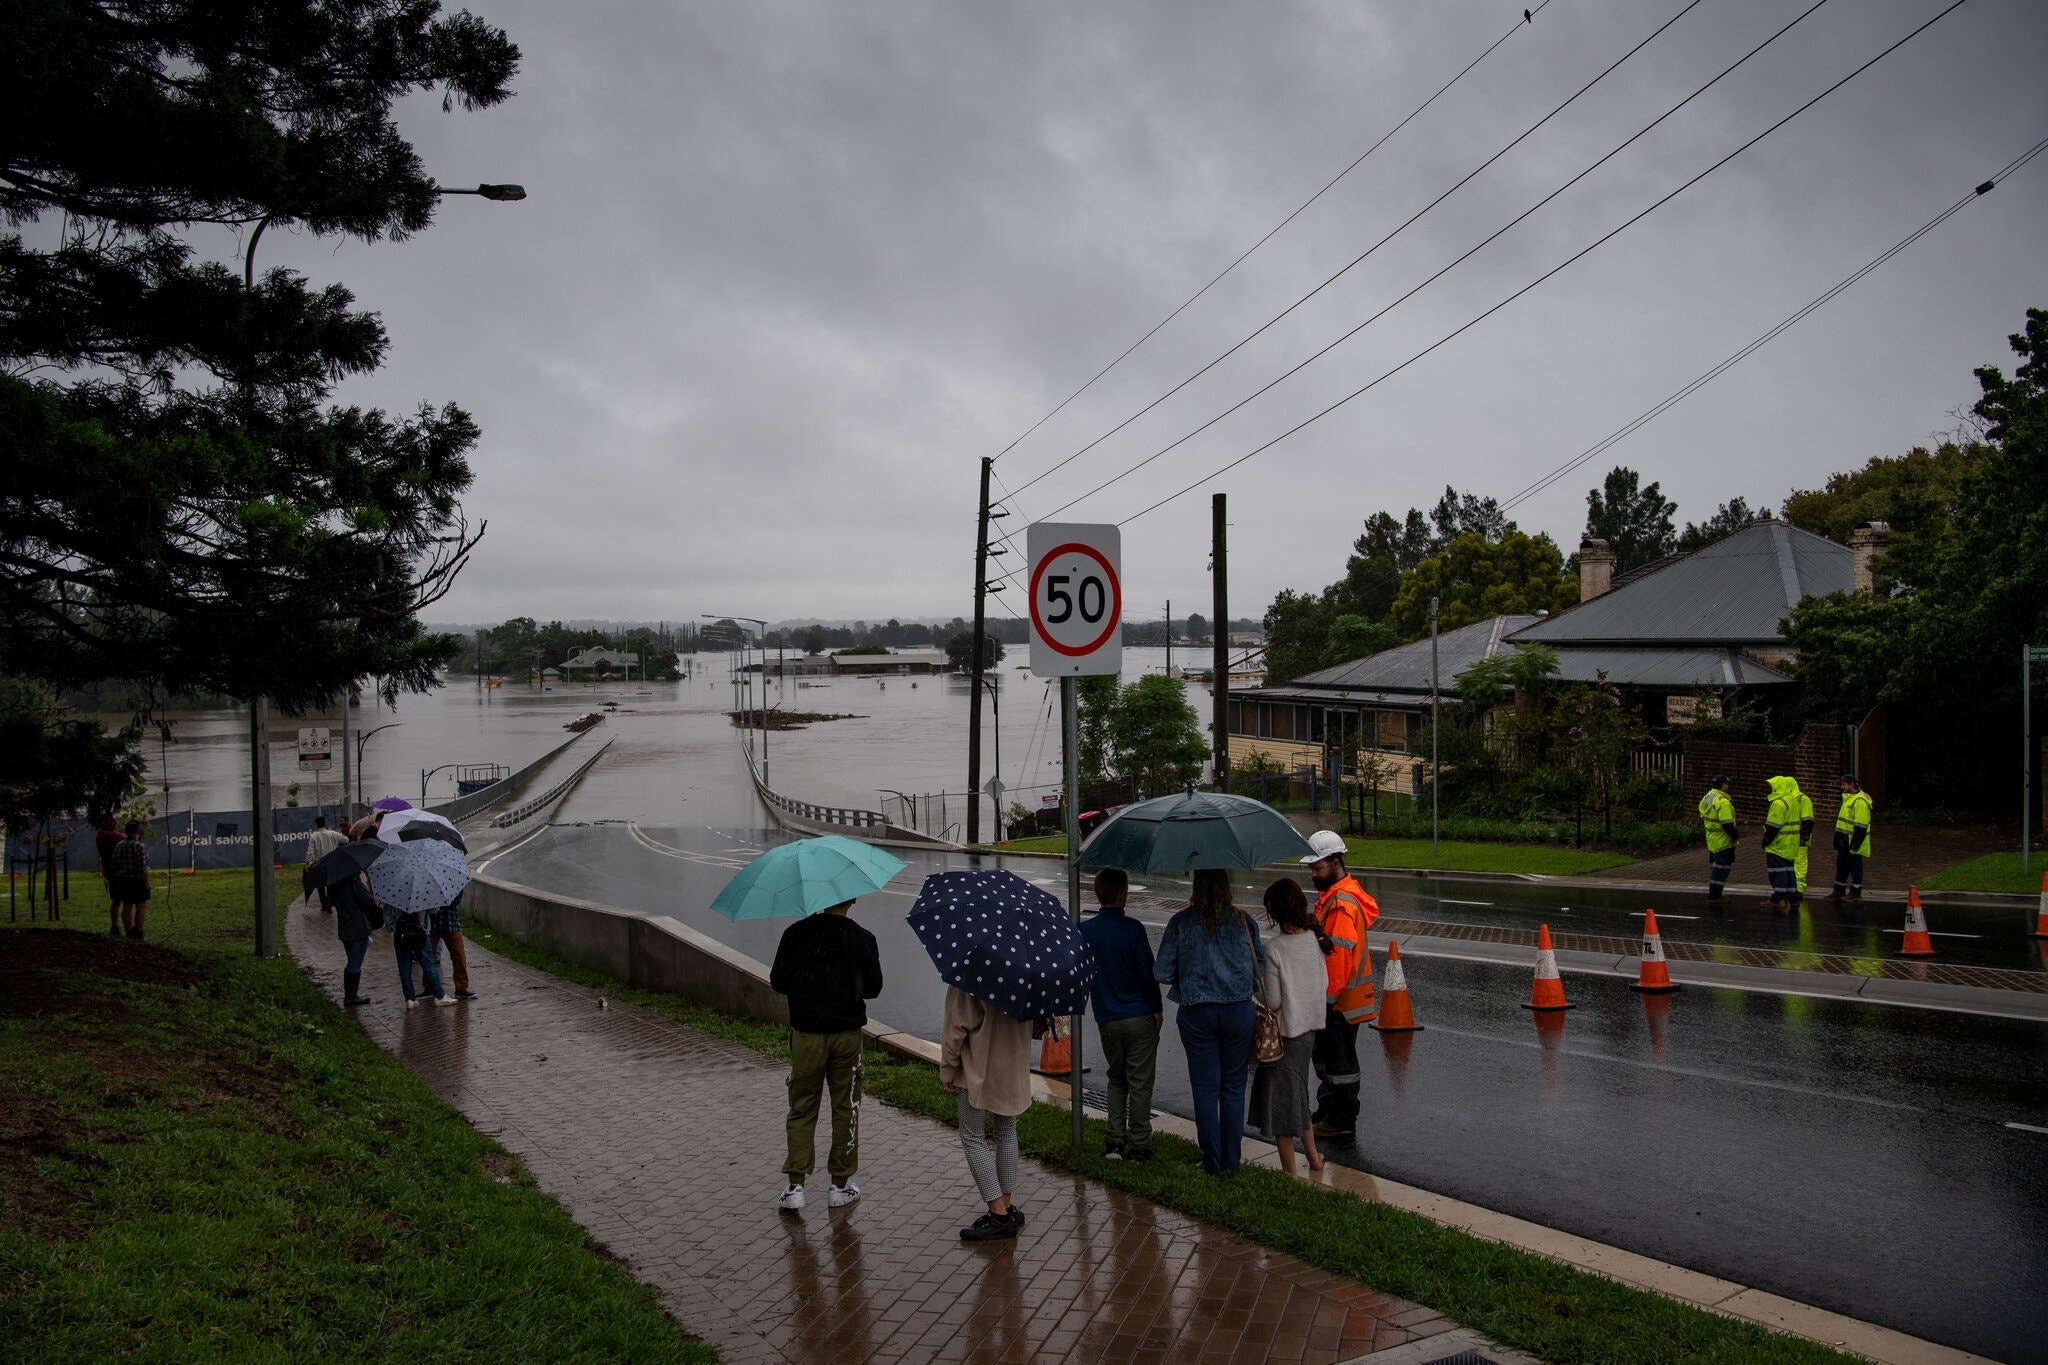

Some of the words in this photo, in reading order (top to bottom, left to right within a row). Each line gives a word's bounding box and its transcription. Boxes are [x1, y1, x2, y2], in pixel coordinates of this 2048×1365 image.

[1047, 575, 1106, 624] 50
[216, 834, 255, 847] salvag
[1644, 942, 1655, 954] TL
